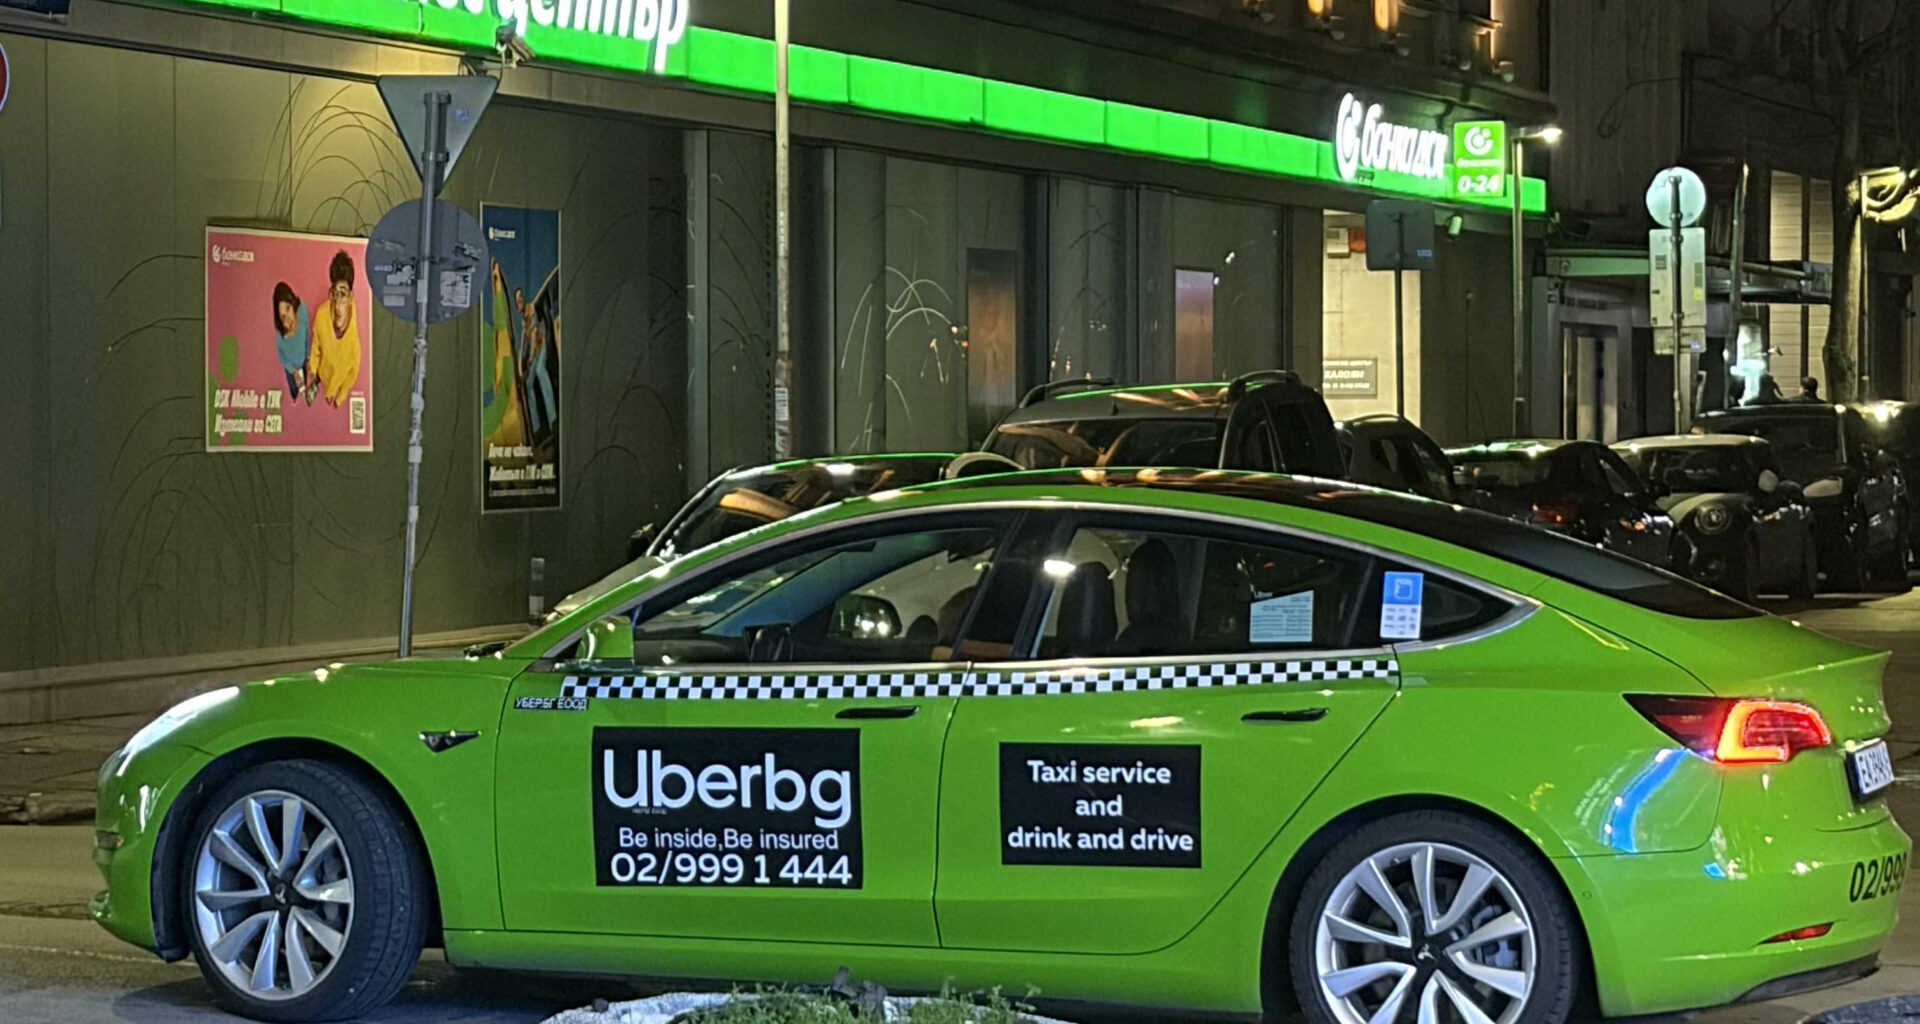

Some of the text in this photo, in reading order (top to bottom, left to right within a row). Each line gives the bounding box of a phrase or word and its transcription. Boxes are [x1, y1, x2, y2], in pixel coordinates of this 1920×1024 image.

[1457, 174, 1500, 194] 0-24
[1026, 760, 1172, 784] Taxi service
[603, 749, 852, 829] Uberbg
[1075, 794, 1123, 816] and
[619, 827, 648, 848] Be
[760, 829, 838, 850] insured
[1007, 826, 1194, 851] drink and drive
[610, 851, 745, 884] 02/999
